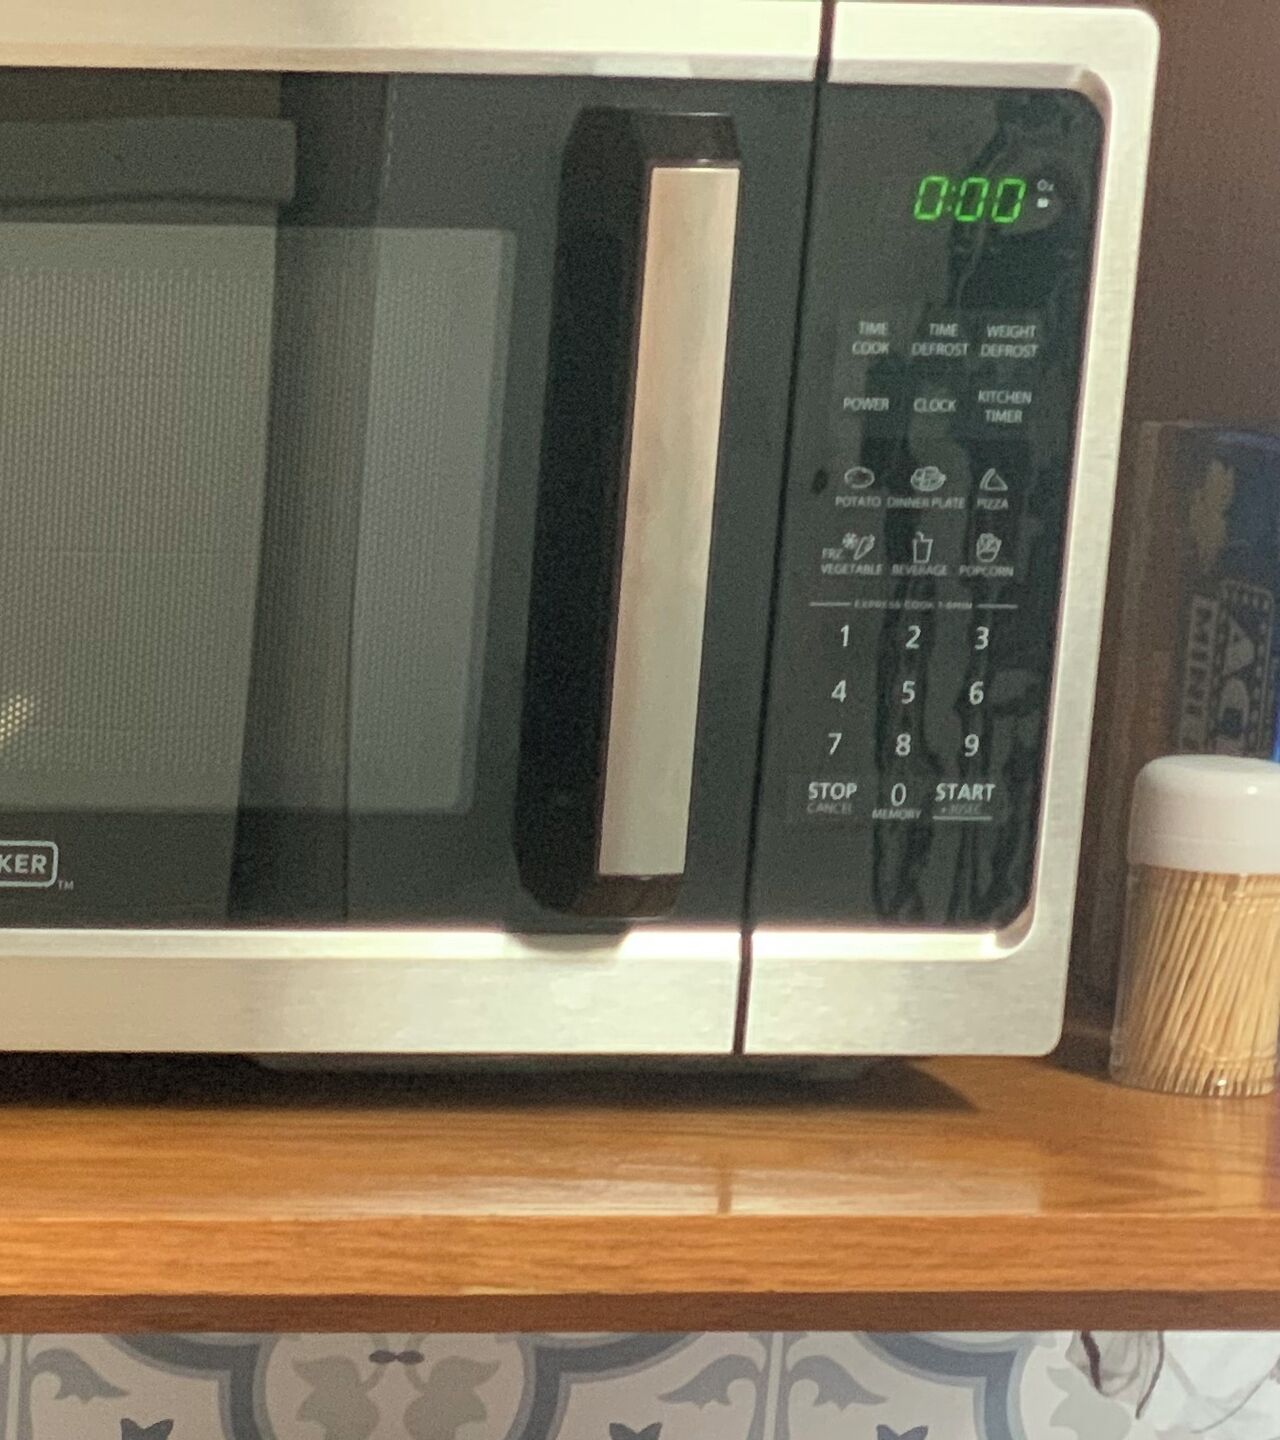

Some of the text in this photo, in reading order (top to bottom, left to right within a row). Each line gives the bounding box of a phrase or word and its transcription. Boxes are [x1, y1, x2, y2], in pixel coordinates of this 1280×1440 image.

[913, 176, 1027, 223] 0:00
[858, 321, 889, 336] TIME
[929, 323, 959, 338] TIME
[986, 324, 1037, 339] WEIGHT
[852, 341, 890, 355] COOK
[911, 342, 969, 357] DEFROST
[980, 344, 1038, 358] DEFROST
[843, 397, 890, 411] POWER
[913, 398, 956, 412] CLOCK
[978, 390, 1032, 404] KITCHEN
[985, 409, 1023, 423] TIMER
[820, 564, 883, 577] VEGETABLE
[959, 565, 1014, 578] POPCORN
[840, 624, 850, 648] 1
[905, 625, 922, 650] 2
[974, 626, 990, 650] 3
[831, 680, 847, 703] 4
[901, 681, 916, 704] 5
[969, 681, 984, 705] 6
[828, 733, 842, 756] 7
[895, 733, 911, 756] 8
[964, 734, 980, 757] 9
[808, 781, 857, 801] STOP
[890, 783, 907, 807] 0
[935, 783, 995, 802] START
[872, 808, 922, 820] MEMORY
